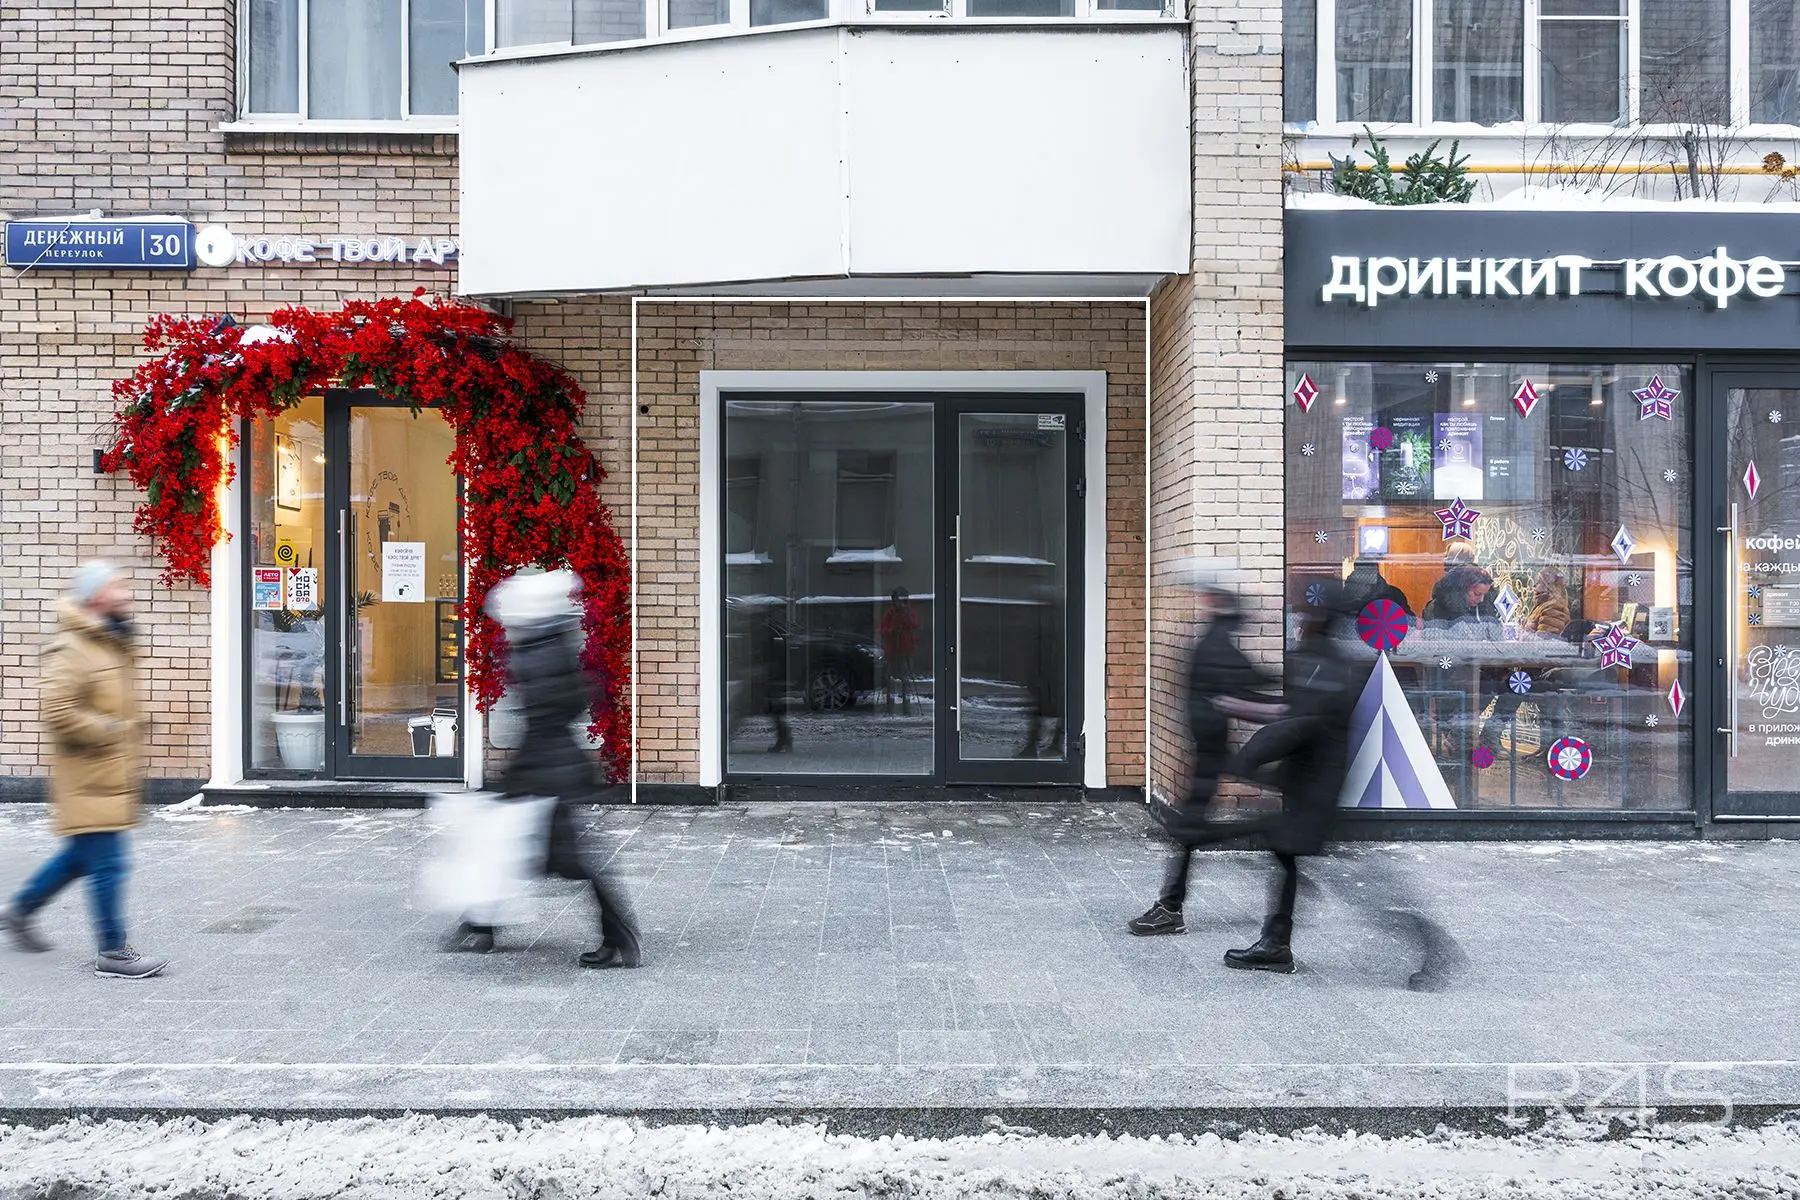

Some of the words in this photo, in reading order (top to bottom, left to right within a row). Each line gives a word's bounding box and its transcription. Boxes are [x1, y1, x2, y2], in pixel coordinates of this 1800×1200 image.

[24, 229, 124, 246] ДЕНЕЖНЫЙ
[150, 234, 181, 256] 30
[45, 249, 104, 258] ПЕРЕУЛОК
[236, 236, 316, 263] КОФЕ
[327, 236, 406, 263] ТВОЙ
[1322, 255, 1592, 307] дринкит
[1626, 246, 1785, 308] кофе
